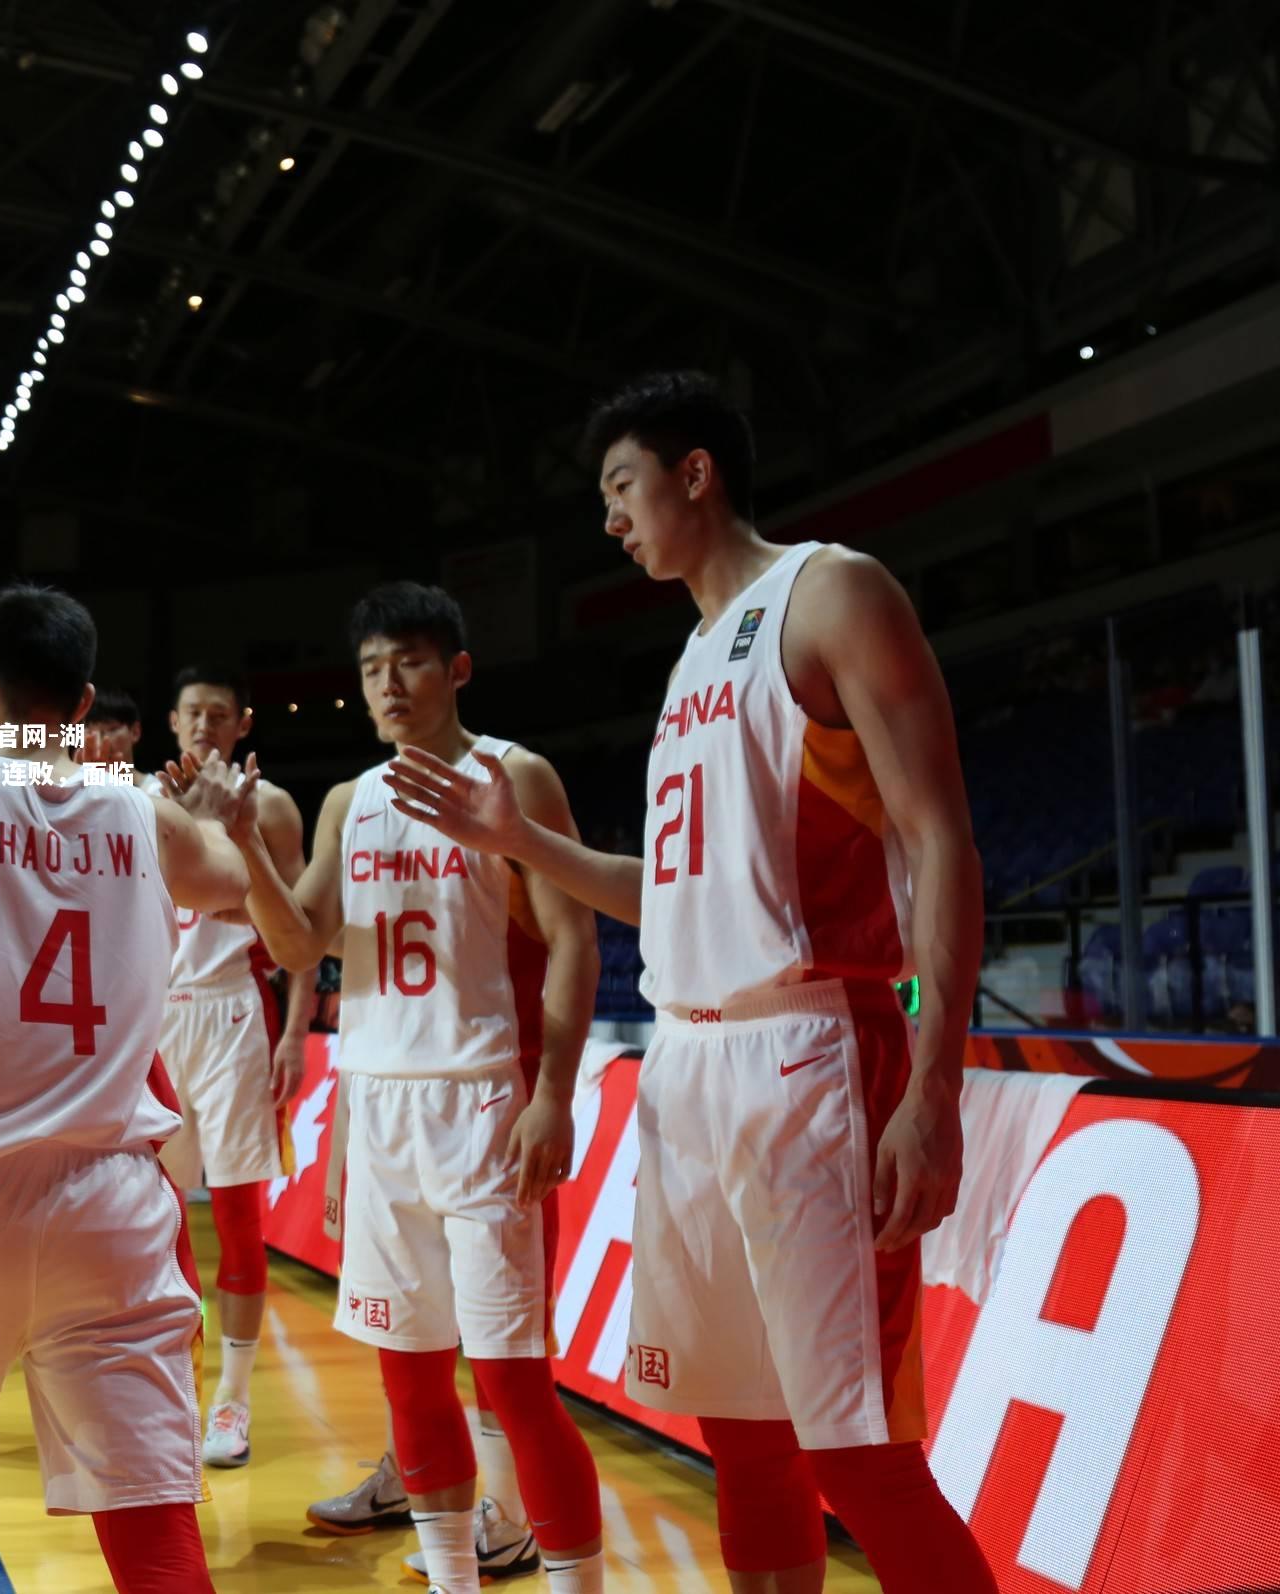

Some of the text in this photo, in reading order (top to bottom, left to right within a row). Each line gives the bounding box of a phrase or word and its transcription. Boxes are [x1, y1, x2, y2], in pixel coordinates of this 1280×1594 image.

[653, 680, 736, 751] CHINA
[655, 763, 704, 885] 21
[351, 846, 469, 882] CHINA
[20, 908, 107, 1055] 4
[375, 909, 437, 997] 16
[690, 1009, 721, 1024] CHN
